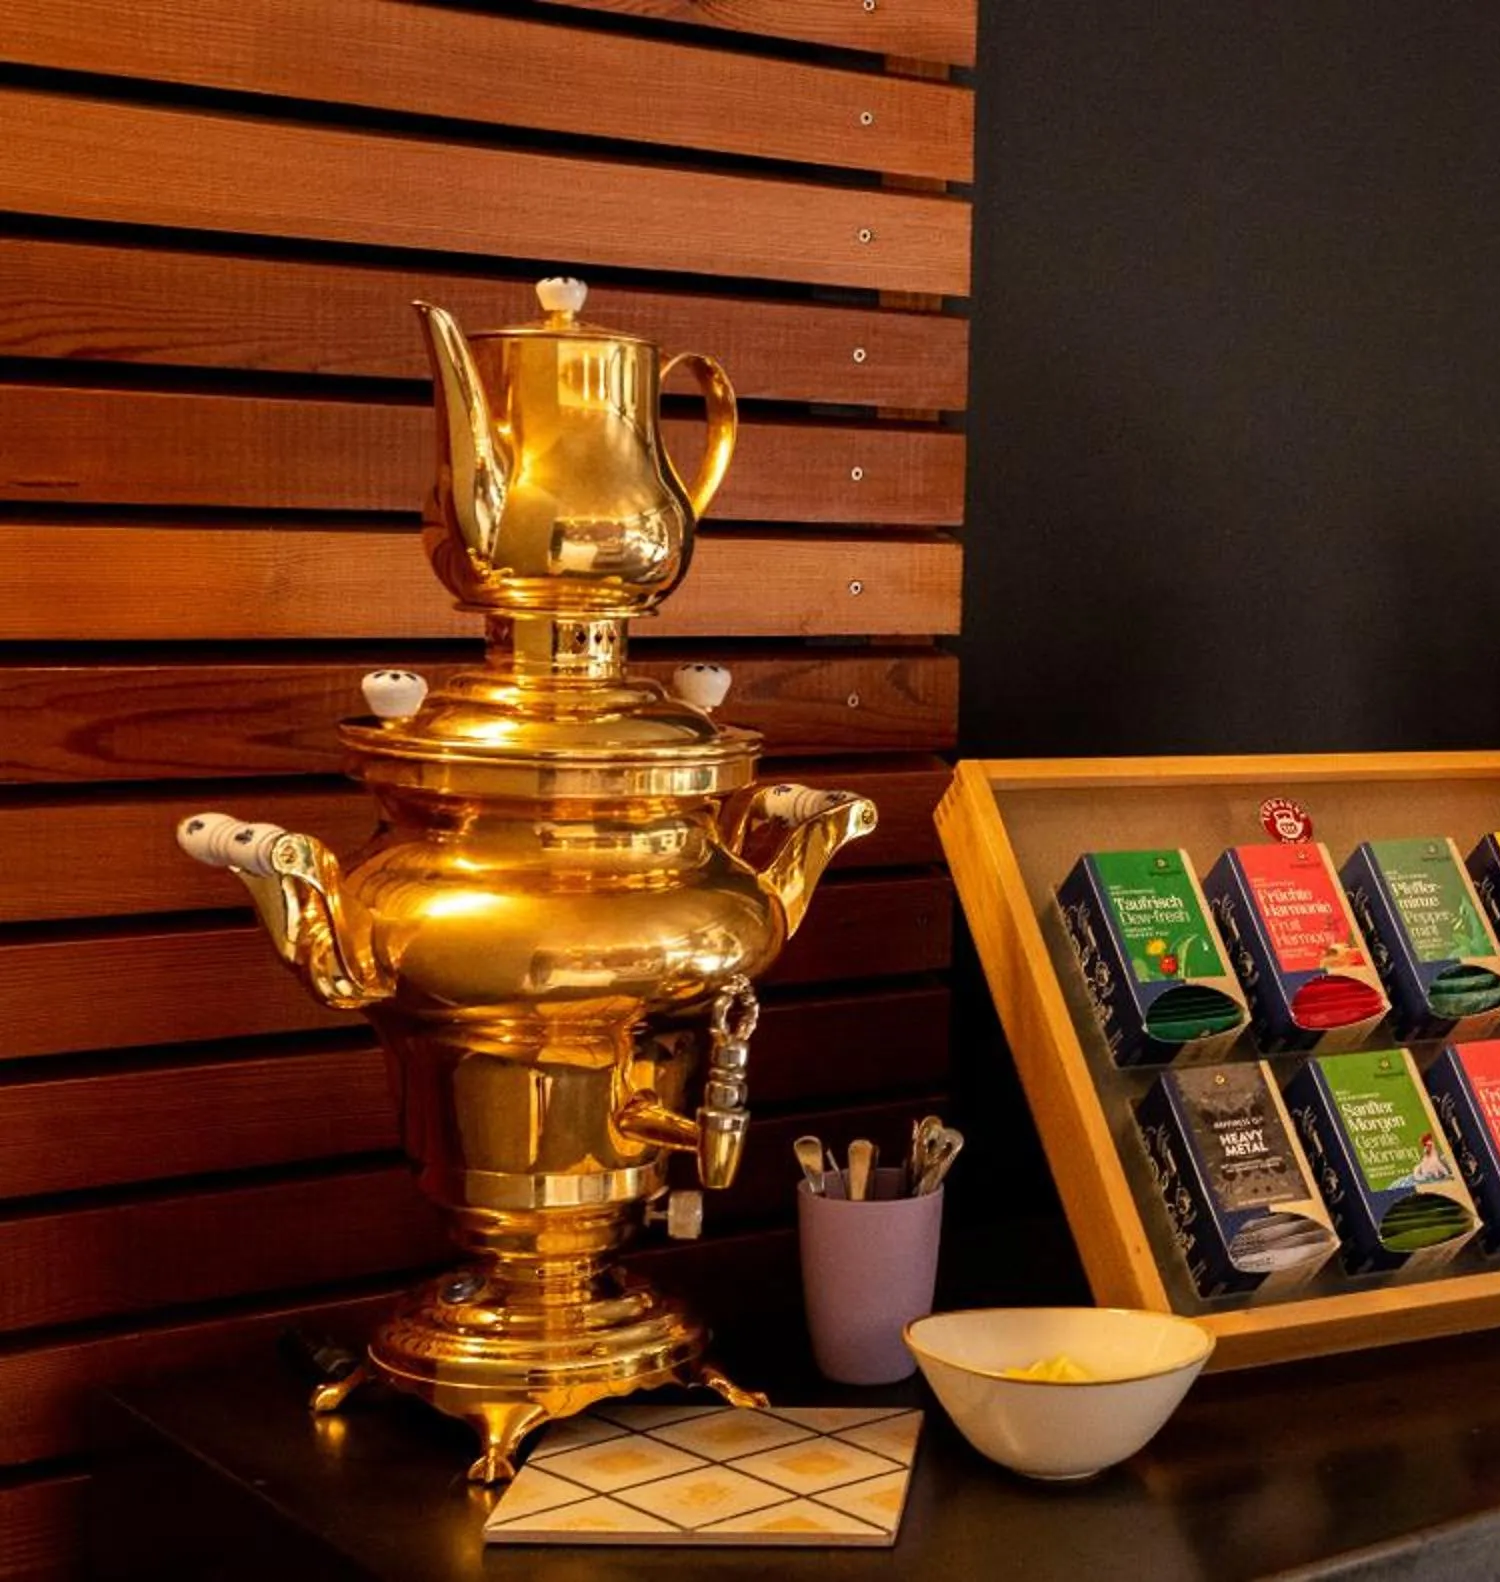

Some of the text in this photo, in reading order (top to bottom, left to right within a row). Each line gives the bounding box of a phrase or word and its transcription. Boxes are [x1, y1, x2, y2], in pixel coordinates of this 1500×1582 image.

[1113, 894, 1184, 911] Taufrisch
[1263, 901, 1332, 917] Harmonie
[1347, 1115, 1406, 1132] Morgen
[1219, 1129, 1264, 1145] HEAVY
[1225, 1141, 1269, 1156] METAL
